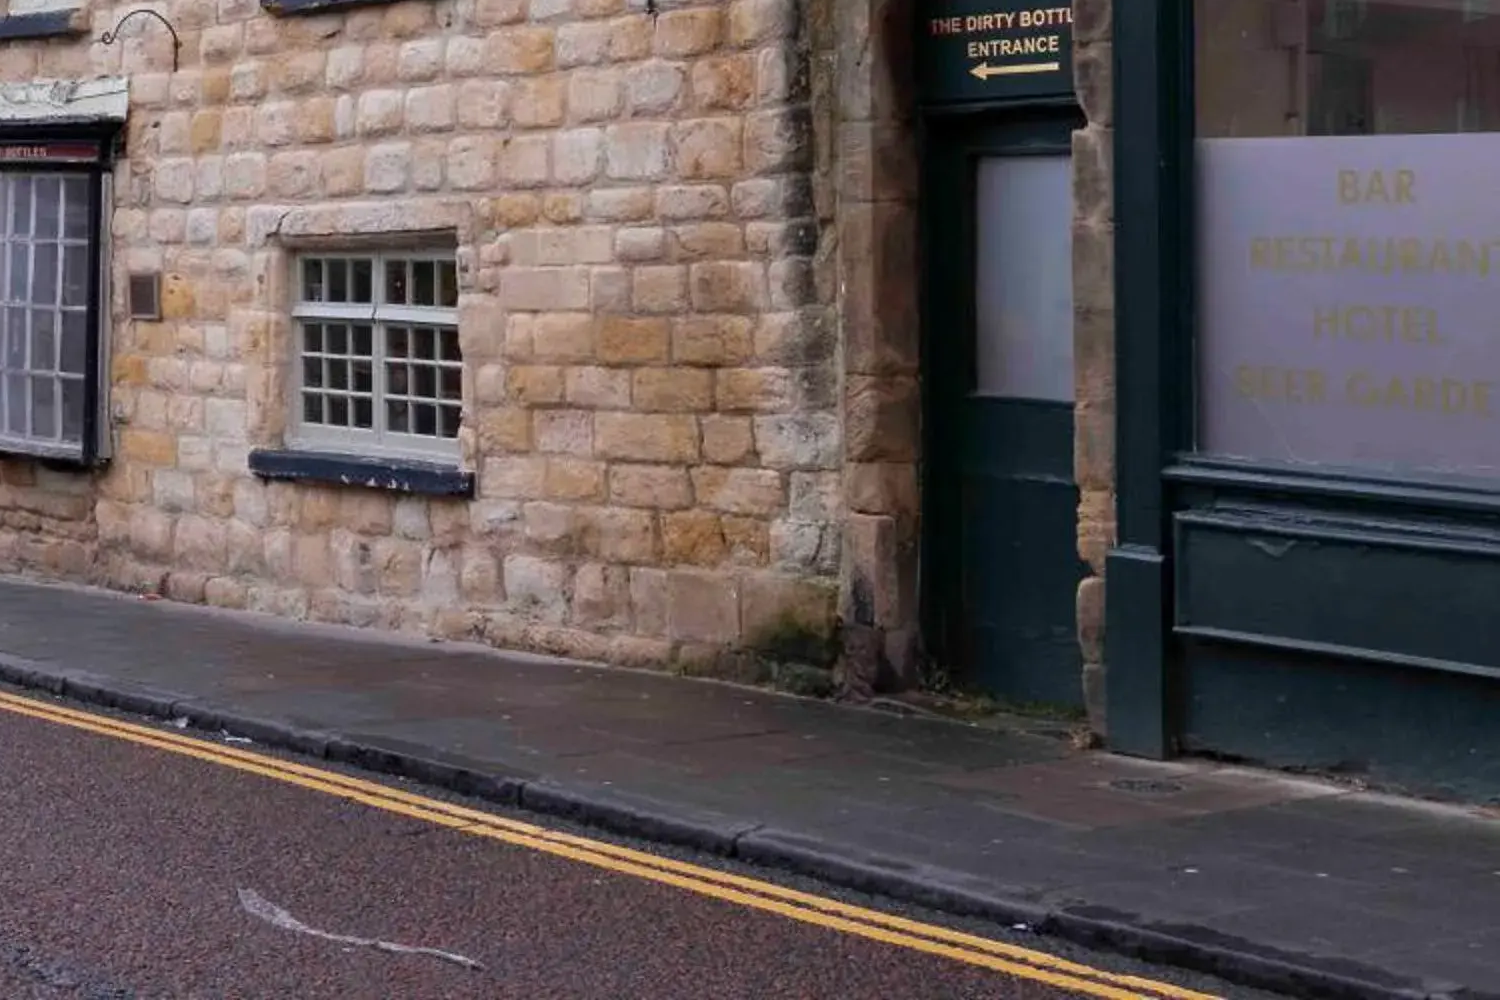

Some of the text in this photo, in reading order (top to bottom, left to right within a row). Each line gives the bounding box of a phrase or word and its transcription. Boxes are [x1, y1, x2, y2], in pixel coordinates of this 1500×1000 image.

[930, 17, 962, 34] THE
[966, 12, 1016, 32] DIRTY
[967, 36, 1060, 57] ENTRANCE
[1337, 169, 1417, 204] BAR
[1312, 305, 1447, 345] HOTEL
[1235, 364, 1327, 404] BEER
